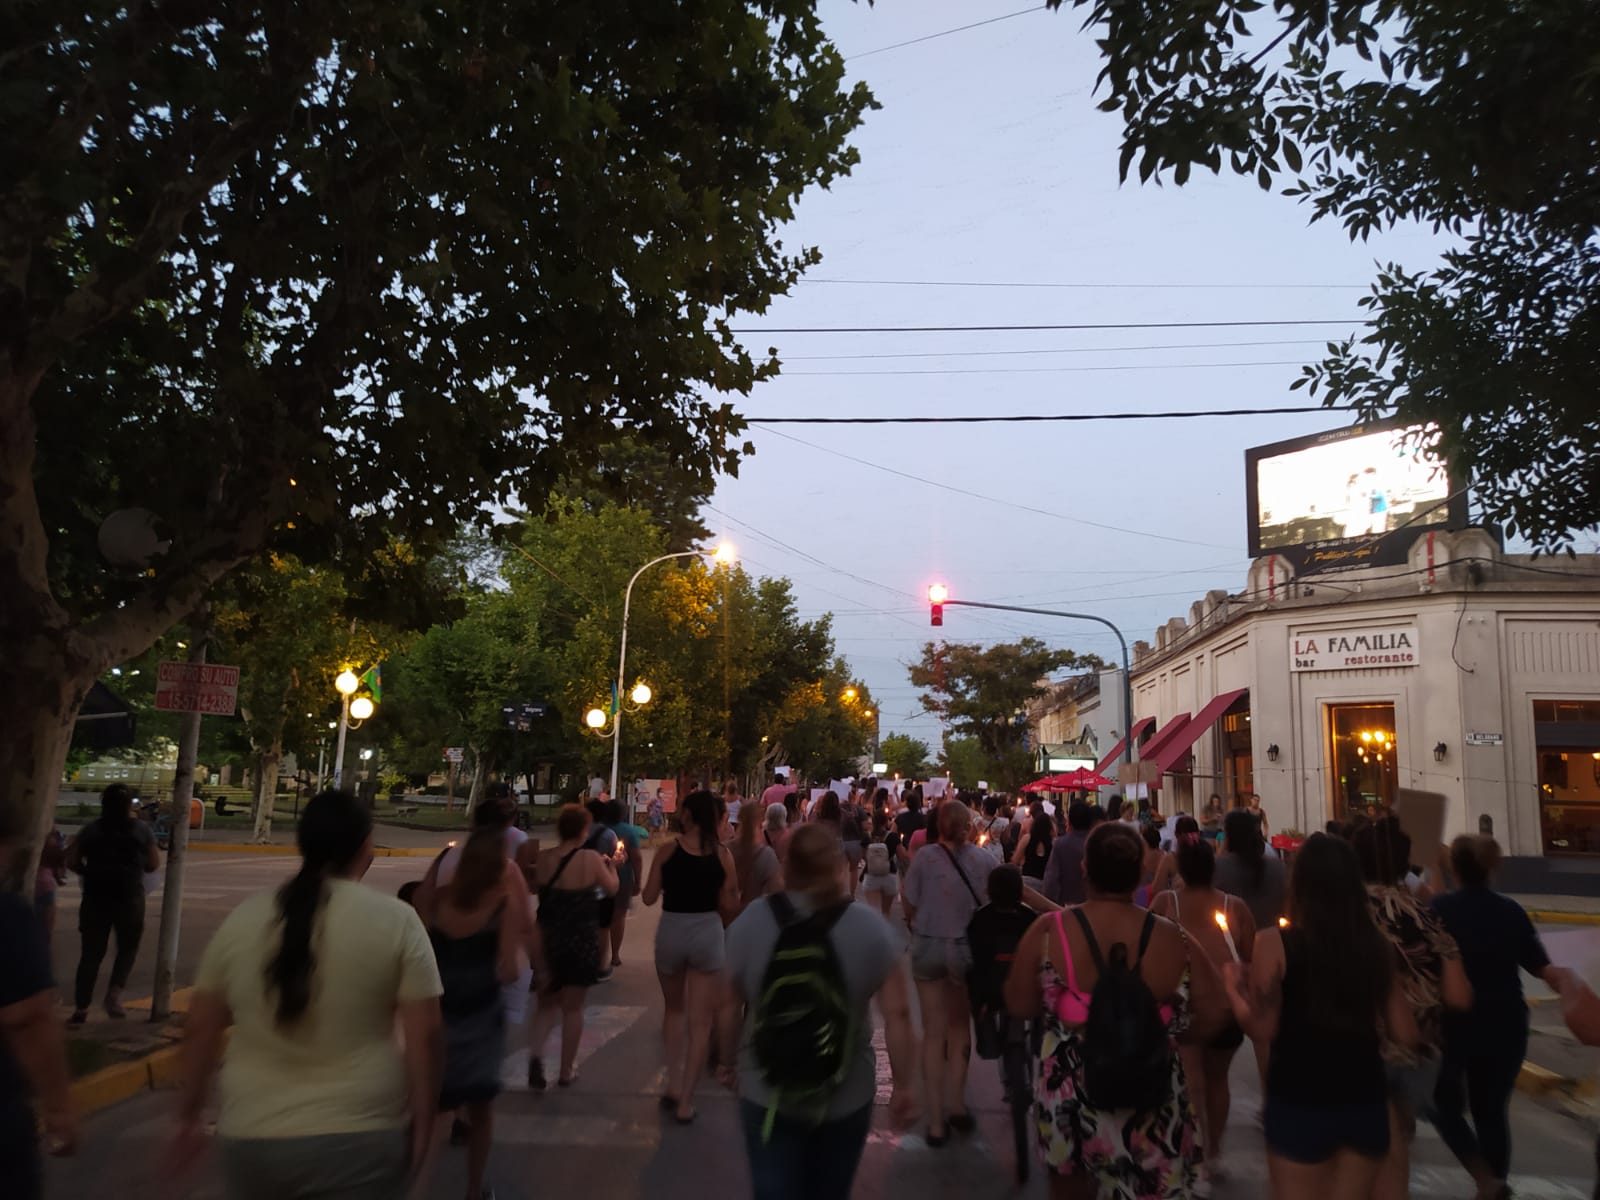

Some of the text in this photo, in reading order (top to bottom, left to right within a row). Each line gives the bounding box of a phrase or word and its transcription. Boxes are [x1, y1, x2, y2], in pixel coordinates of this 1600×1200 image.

[1295, 632, 1412, 655] LA FAMILIA
[1295, 652, 1414, 668] bar restorante
[161, 664, 237, 687] COMPRO SU AUTO
